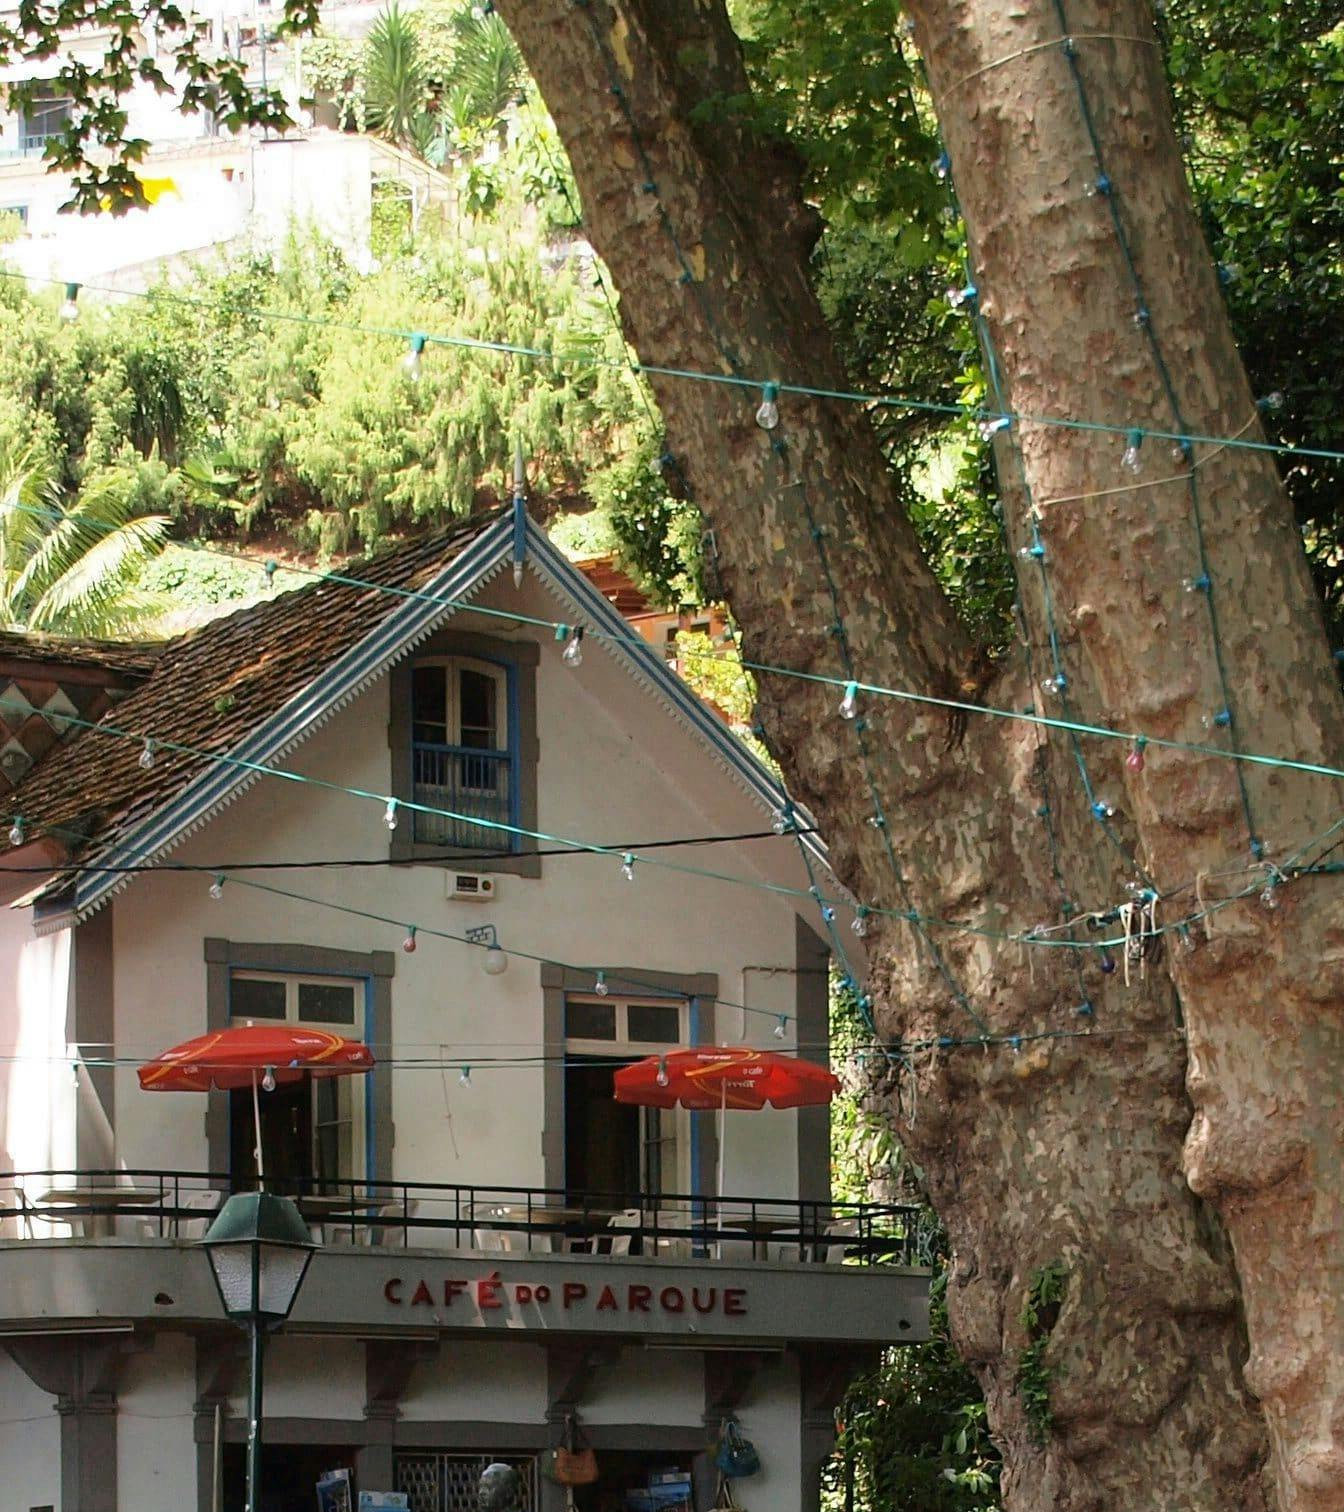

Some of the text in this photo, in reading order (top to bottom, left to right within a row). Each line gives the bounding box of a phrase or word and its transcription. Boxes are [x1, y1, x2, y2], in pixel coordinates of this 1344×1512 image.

[384, 1271, 747, 1316] CAFÉ DO PARQUE
